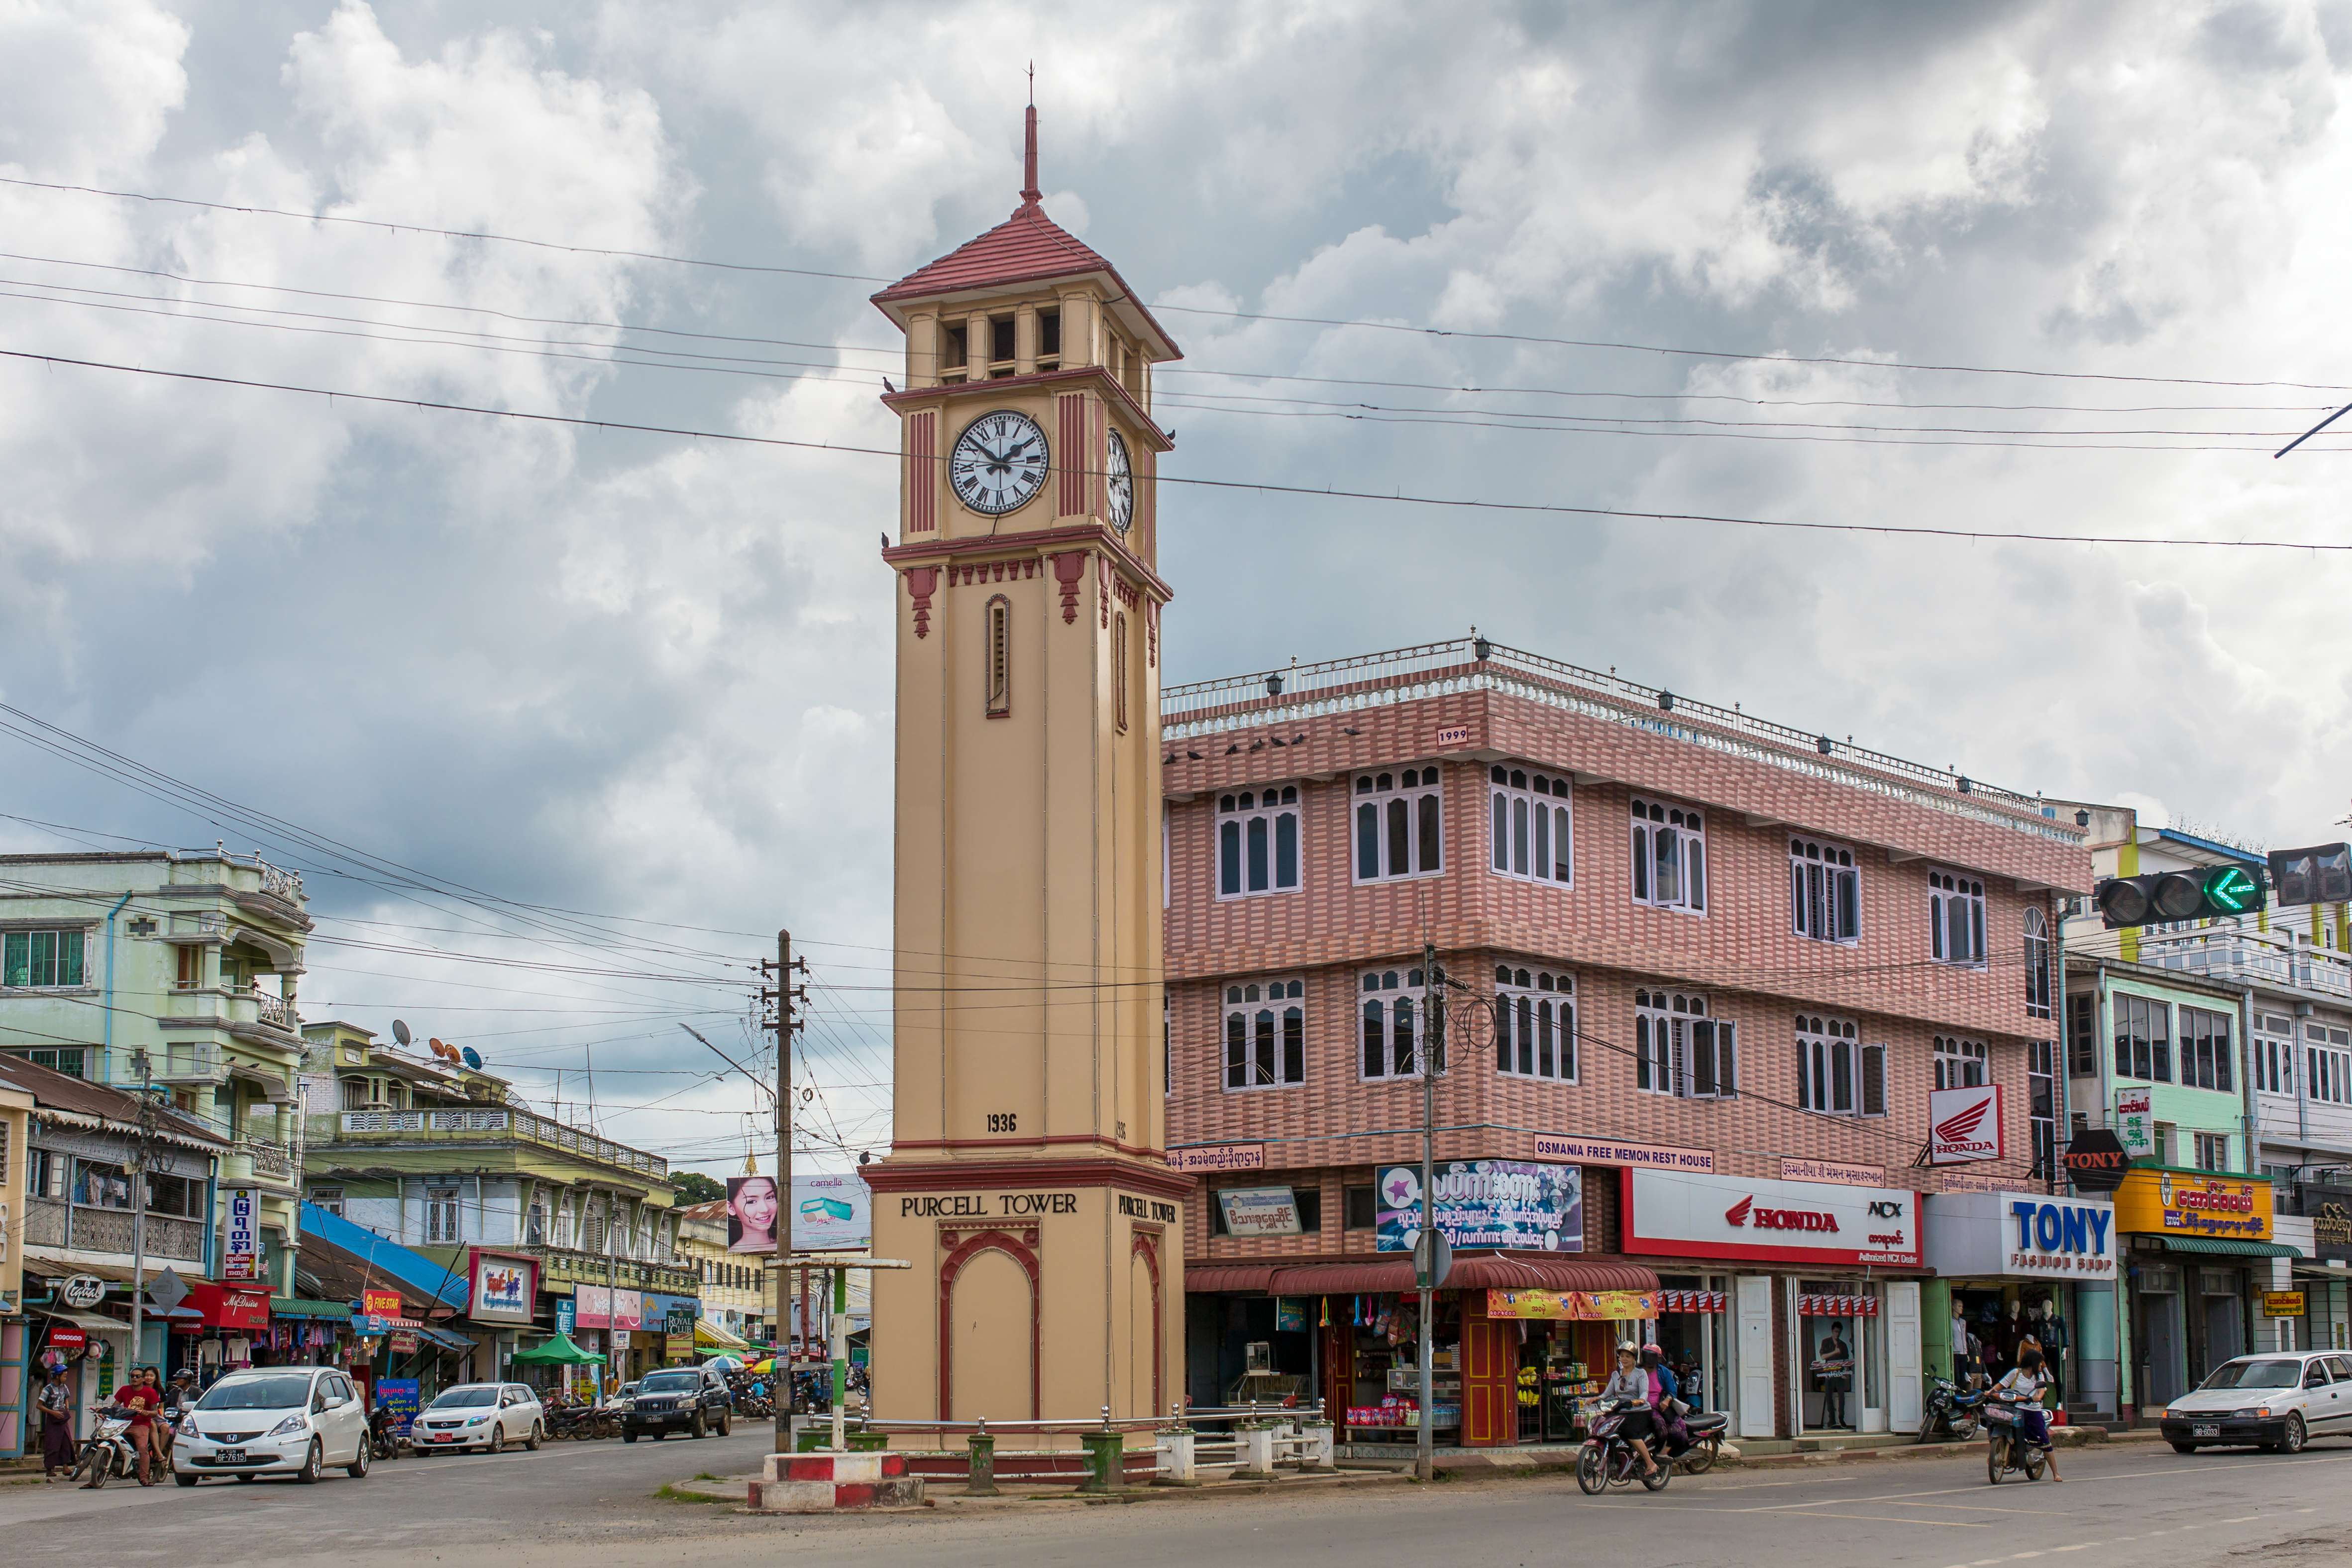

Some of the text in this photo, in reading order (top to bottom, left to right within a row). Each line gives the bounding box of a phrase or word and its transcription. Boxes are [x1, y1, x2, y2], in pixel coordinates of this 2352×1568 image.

[1440, 730, 1466, 741] 1999
[987, 1113, 1017, 1132] 1936
[1537, 1141, 1711, 1167] OSMANIA FREE MEMON REST HOUSE
[1935, 1141, 1996, 1153] HONDA
[2063, 1151, 2124, 1168] TONY
[811, 1177, 842, 1187] camella
[901, 1193, 1077, 1217] PURCELL TOWER
[1119, 1194, 1176, 1224] PURCELL TOWER
[1868, 1201, 1903, 1218] NCX
[1754, 1208, 1840, 1232] HONDA
[2010, 1201, 2112, 1254] TONY
[1859, 1252, 1918, 1263] Authorized NCX Dealer
[2011, 1253, 2112, 1271] FASHION SHOP
[374, 1297, 399, 1310] FIVE STAR
[668, 1316, 692, 1327] ROYAL
[670, 1324, 692, 1336] CLUB
[217, 1453, 244, 1462] 6F-7615
